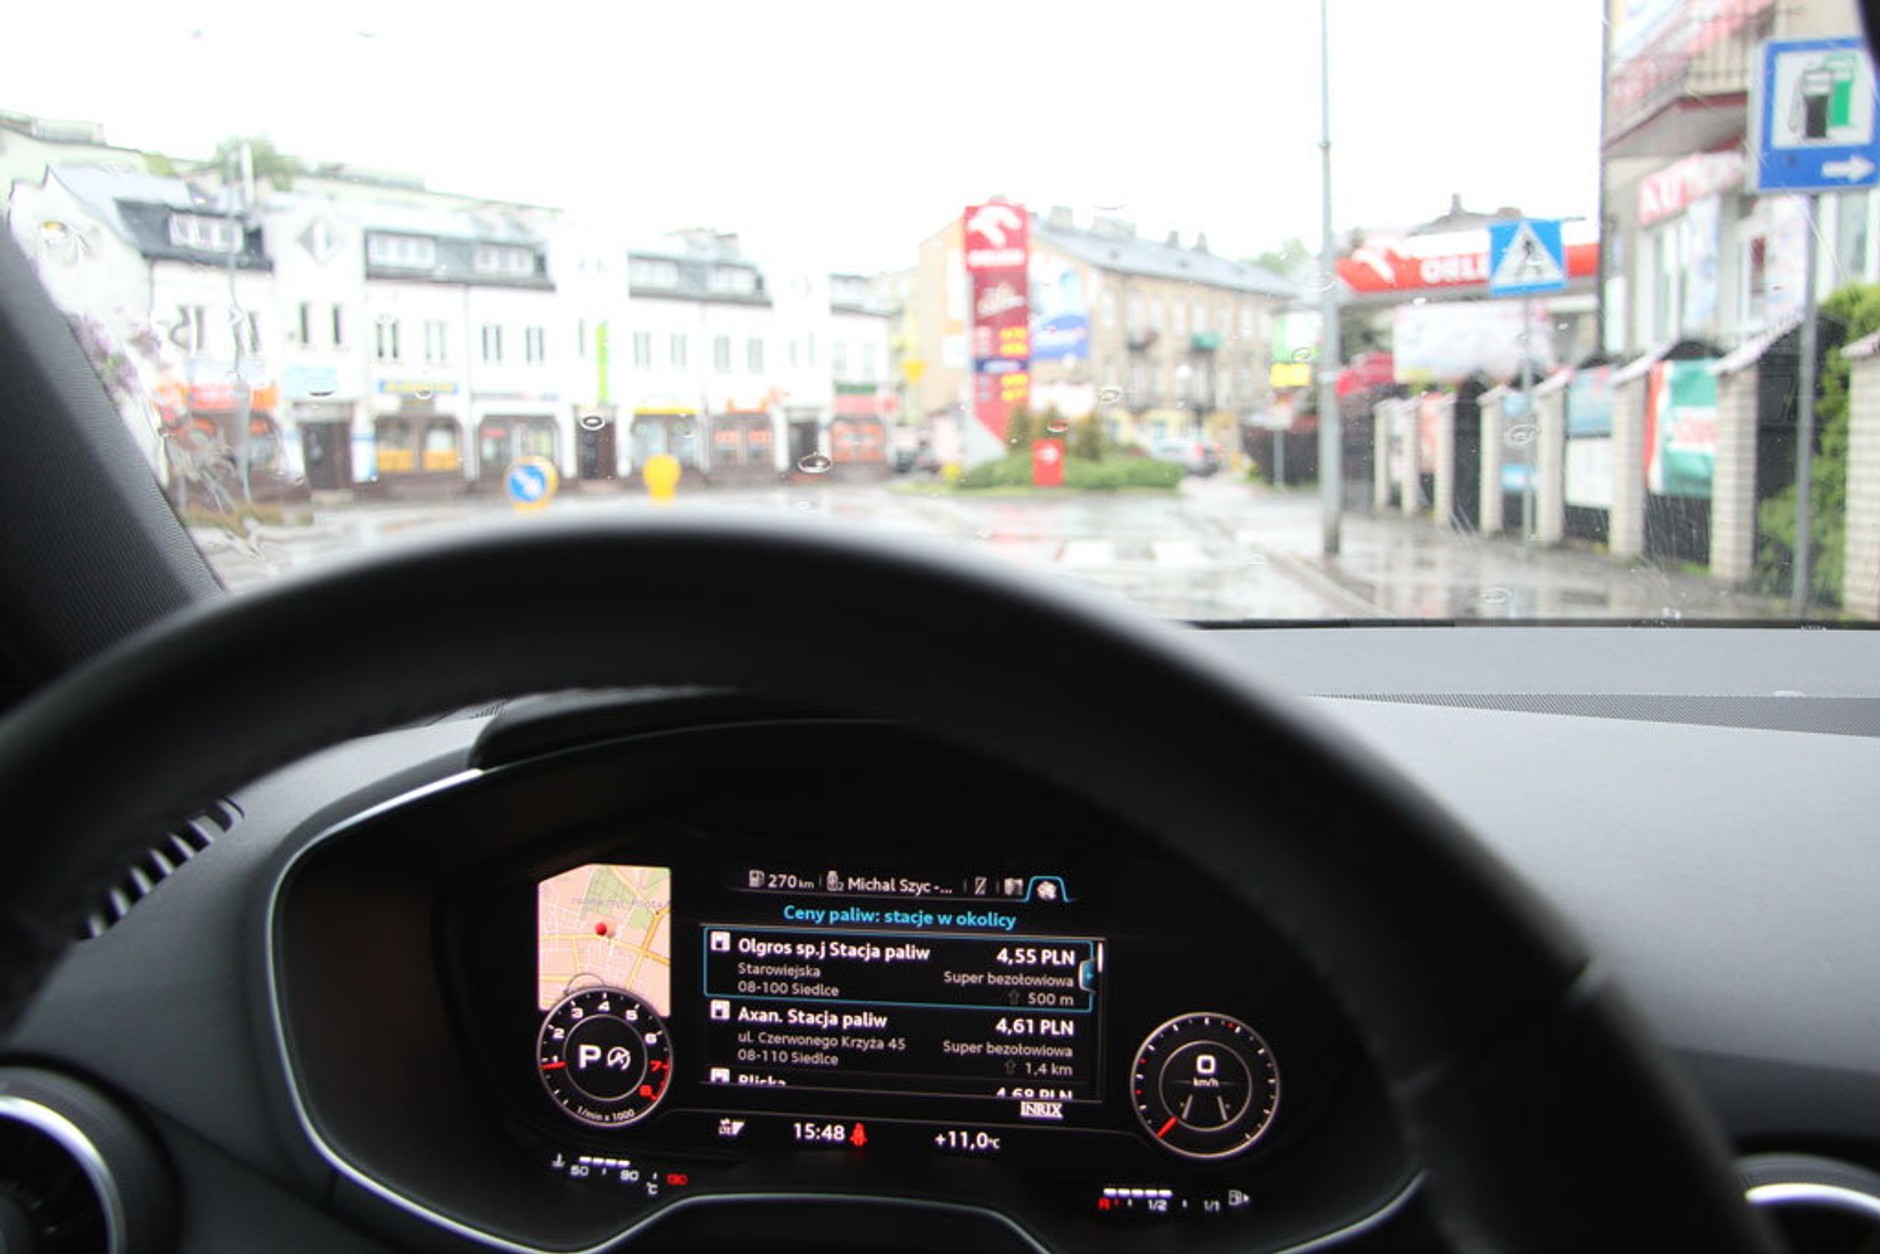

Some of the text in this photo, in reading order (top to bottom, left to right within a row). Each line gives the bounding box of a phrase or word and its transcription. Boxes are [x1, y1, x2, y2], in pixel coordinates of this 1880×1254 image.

[847, 877, 895, 892] Michal
[900, 879, 931, 896] Szyc
[783, 905, 1017, 931] Ceny paliw: stacje w okolicy
[738, 938, 931, 963] Olgros sp.j Stacja paliw
[997, 947, 1076, 966] 4,55 PLN
[738, 962, 822, 979] Starowiejska
[943, 971, 1074, 989] Super bezołowiowa
[738, 981, 840, 997] 08-100 Siedlce
[597, 1000, 611, 1012] 4
[1028, 992, 1075, 1007] 500 m
[571, 1007, 584, 1020] 3
[625, 1009, 638, 1021] 5
[738, 1006, 888, 1029] Axan. Stacja paliw
[553, 1028, 566, 1039] 2
[995, 1017, 1075, 1036] 4,61 PLN
[644, 1032, 658, 1045] 6
[758, 1031, 839, 1050] Czerwonego
[887, 1037, 906, 1051] 45
[578, 1044, 602, 1069] P
[738, 1049, 839, 1066] 08-110 Siedlce
[942, 1040, 1074, 1059] Super bezołowiowa
[650, 1061, 662, 1072] 7
[1025, 1061, 1074, 1076] 1,4 km
[1196, 1055, 1216, 1074] 0
[1193, 1076, 1220, 1088] km/h
[1020, 1101, 1062, 1118] INRIX
[793, 1122, 845, 1141] 15:48
[570, 1165, 590, 1177] 50
